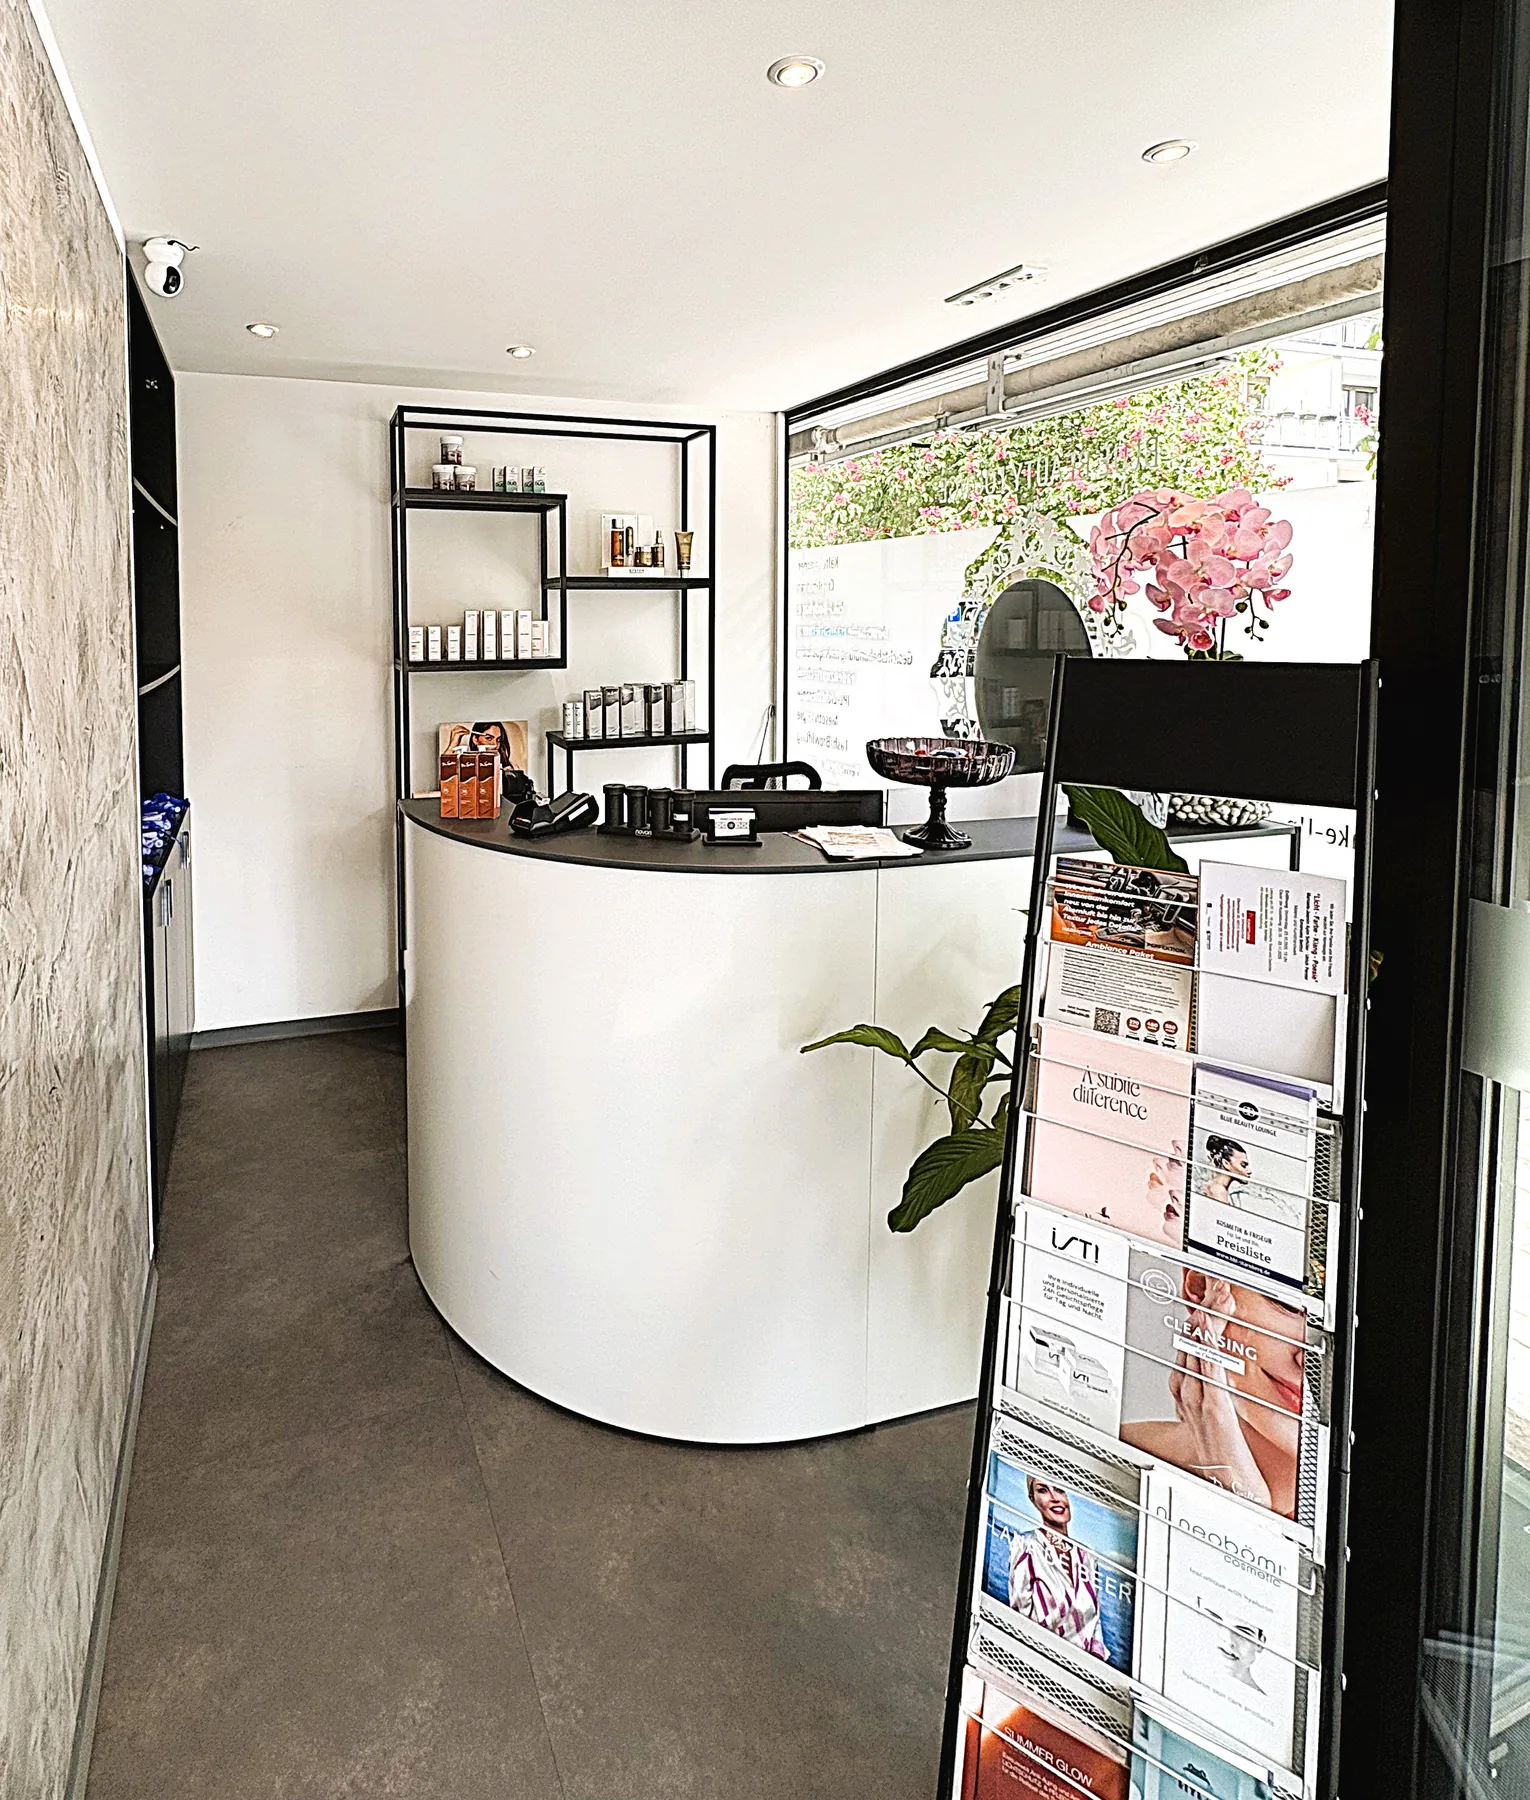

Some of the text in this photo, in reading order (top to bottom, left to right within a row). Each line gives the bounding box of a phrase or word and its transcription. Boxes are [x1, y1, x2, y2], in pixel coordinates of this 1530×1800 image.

[1085, 941, 1155, 960] Ambiance Paket
[1311, 938, 1319, 955] Klang
[1073, 1084, 1148, 1120] difference
[1234, 1118, 1255, 1130] BEAUTY
[1255, 1125, 1277, 1137] LOUNGE
[1216, 1219, 1242, 1234] KOSMETIK
[1249, 1231, 1272, 1244] FRISEUR
[1216, 1235, 1272, 1264] Preisliste
[1055, 1297, 1066, 1307] Tag
[1067, 1303, 1081, 1312] und
[1163, 1315, 1257, 1361] CLEANSING
[1077, 1561, 1132, 1604] BEER
[1224, 1555, 1281, 1588] cosmetic
[1004, 1726, 1053, 1764] SUMMER
[1056, 1758, 1093, 1787] GLOW
